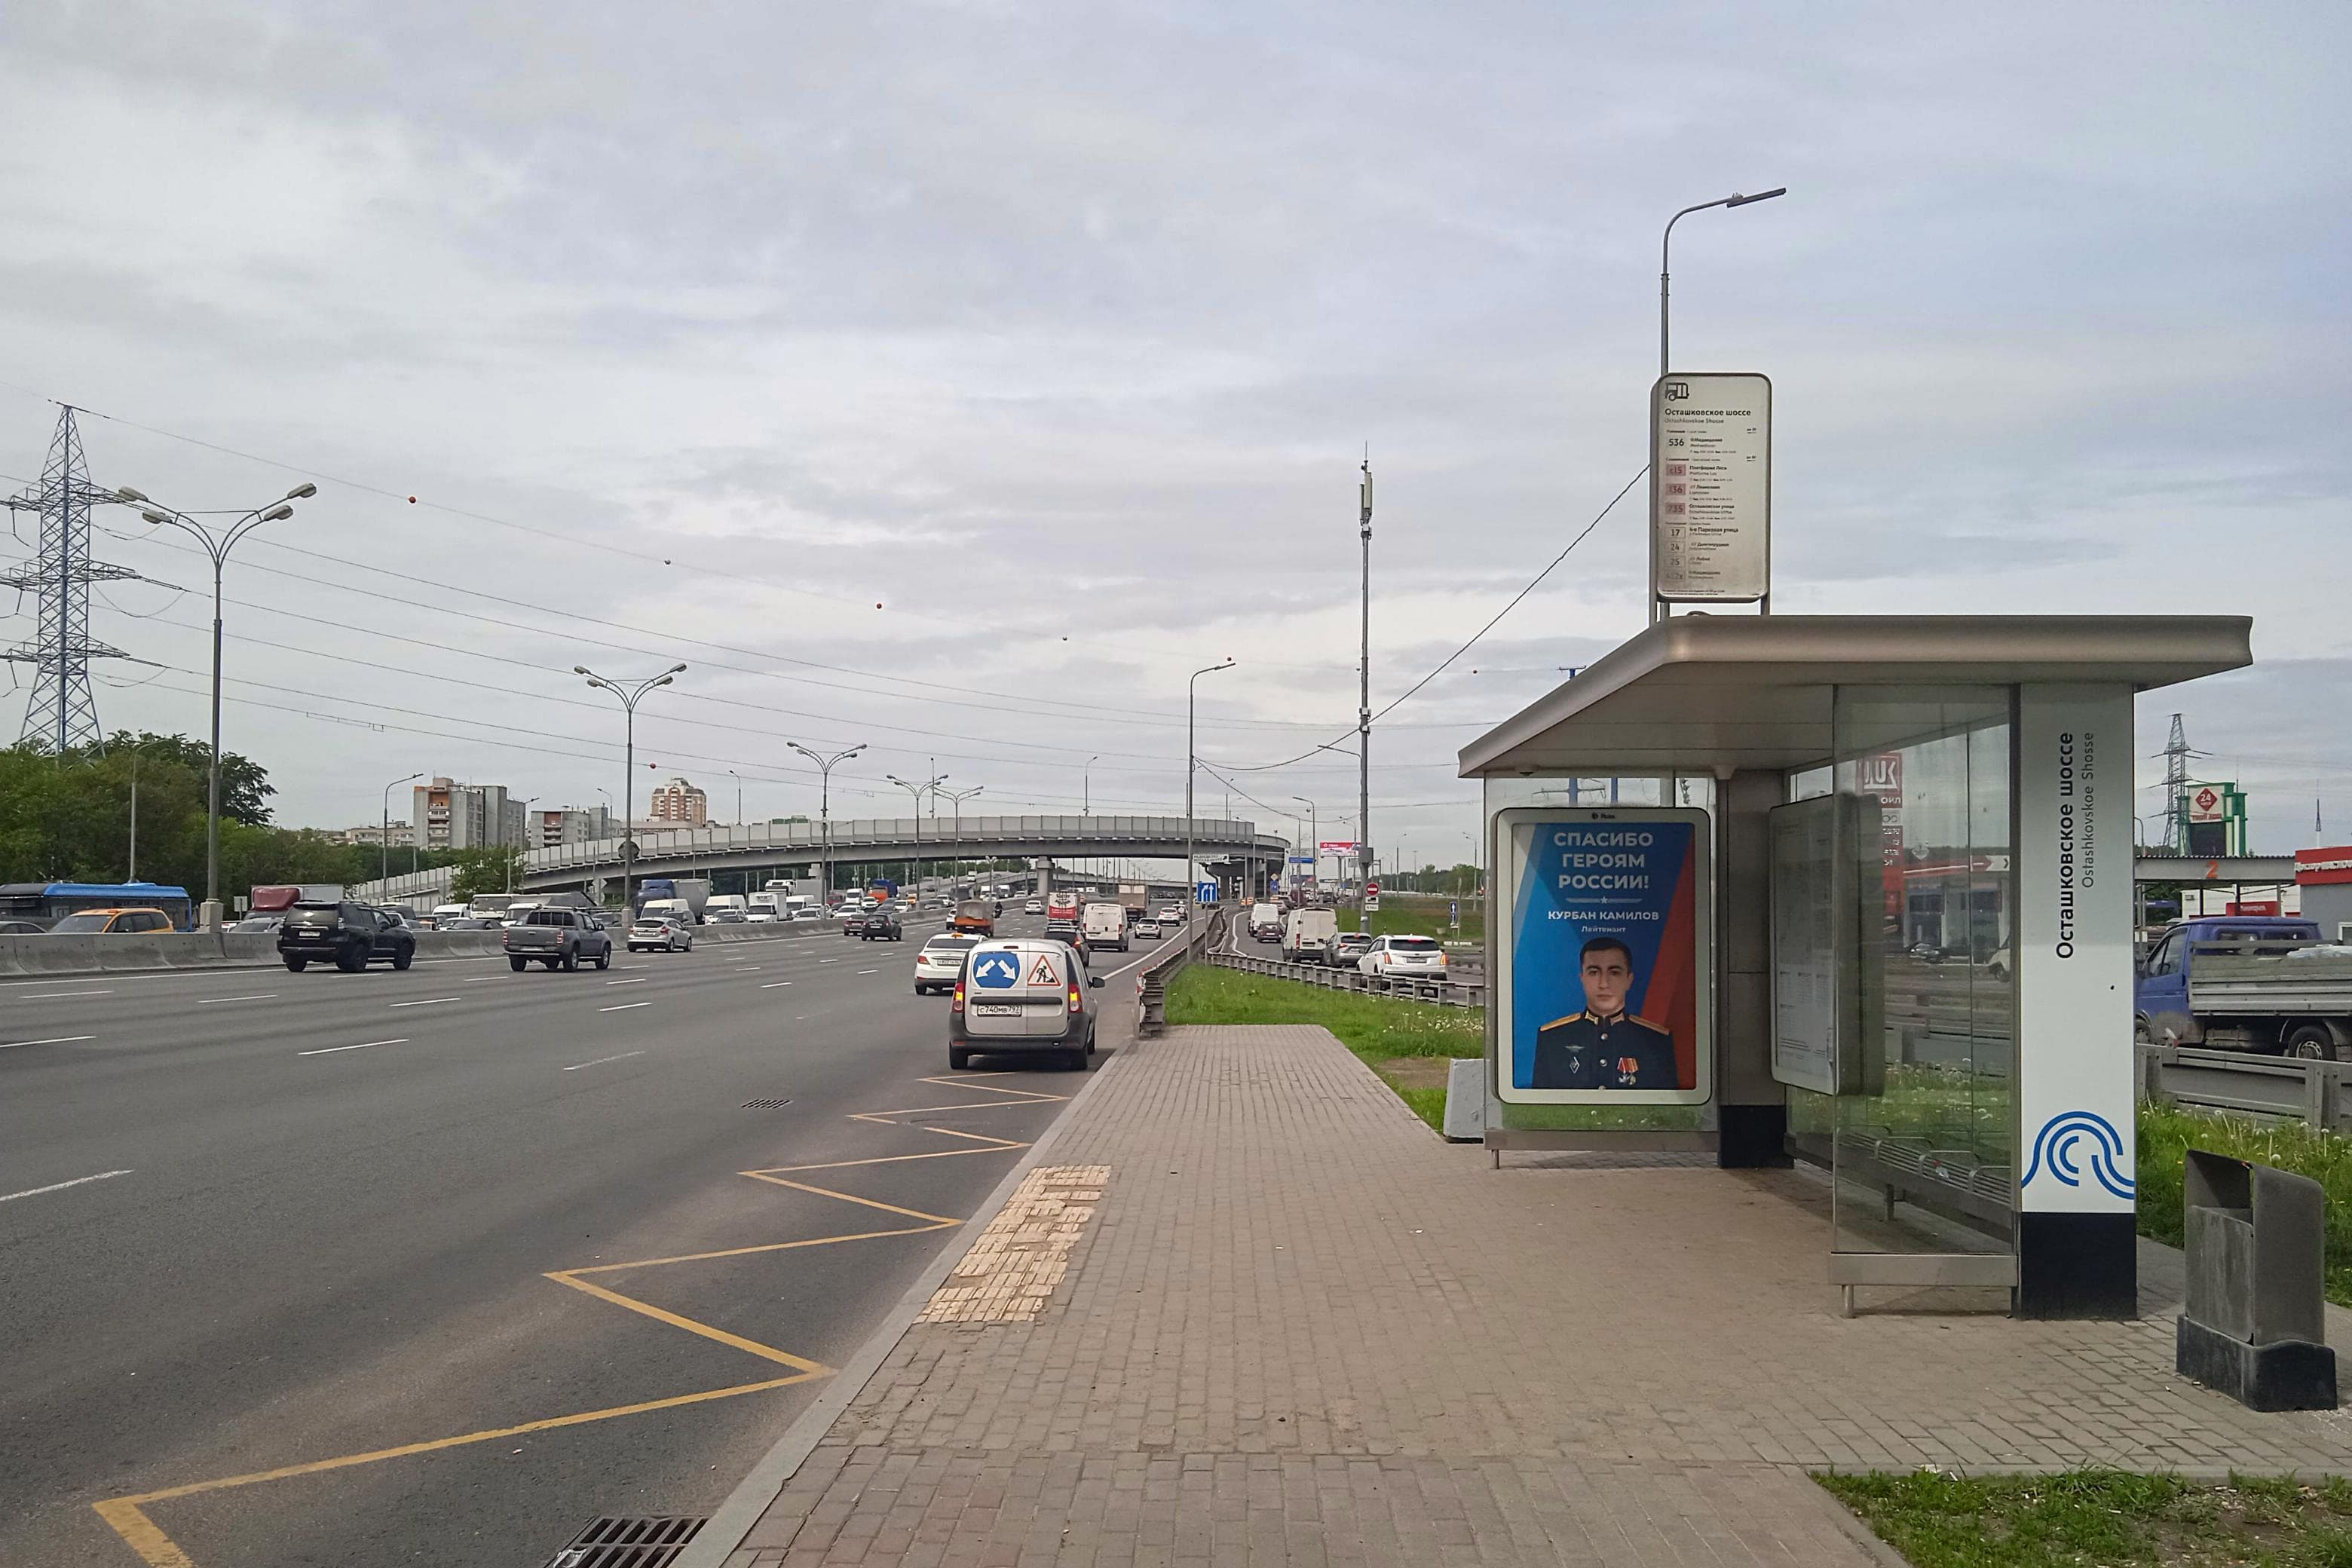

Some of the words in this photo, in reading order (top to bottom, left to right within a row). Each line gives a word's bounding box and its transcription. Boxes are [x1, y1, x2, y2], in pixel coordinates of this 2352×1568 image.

[1664, 408, 1724, 416] Осташковское
[1668, 504, 1683, 513] 735
[2082, 732, 2094, 779] Shosse
[2060, 732, 2074, 796] шоссе
[1553, 831, 1654, 847] СПАСИБО
[2082, 786, 2094, 888] Ostashkovskoe
[1562, 853, 1646, 868] ГЕРОЯМ
[2207, 860, 2219, 879] 2
[1558, 874, 1649, 890] РОССИИ!
[2056, 804, 2074, 960] Осташковское
[1548, 911, 1597, 920] КУРБАН
[1600, 911, 1659, 920] КАМИЛОВ
[1582, 924, 1627, 933] Лейтенант
